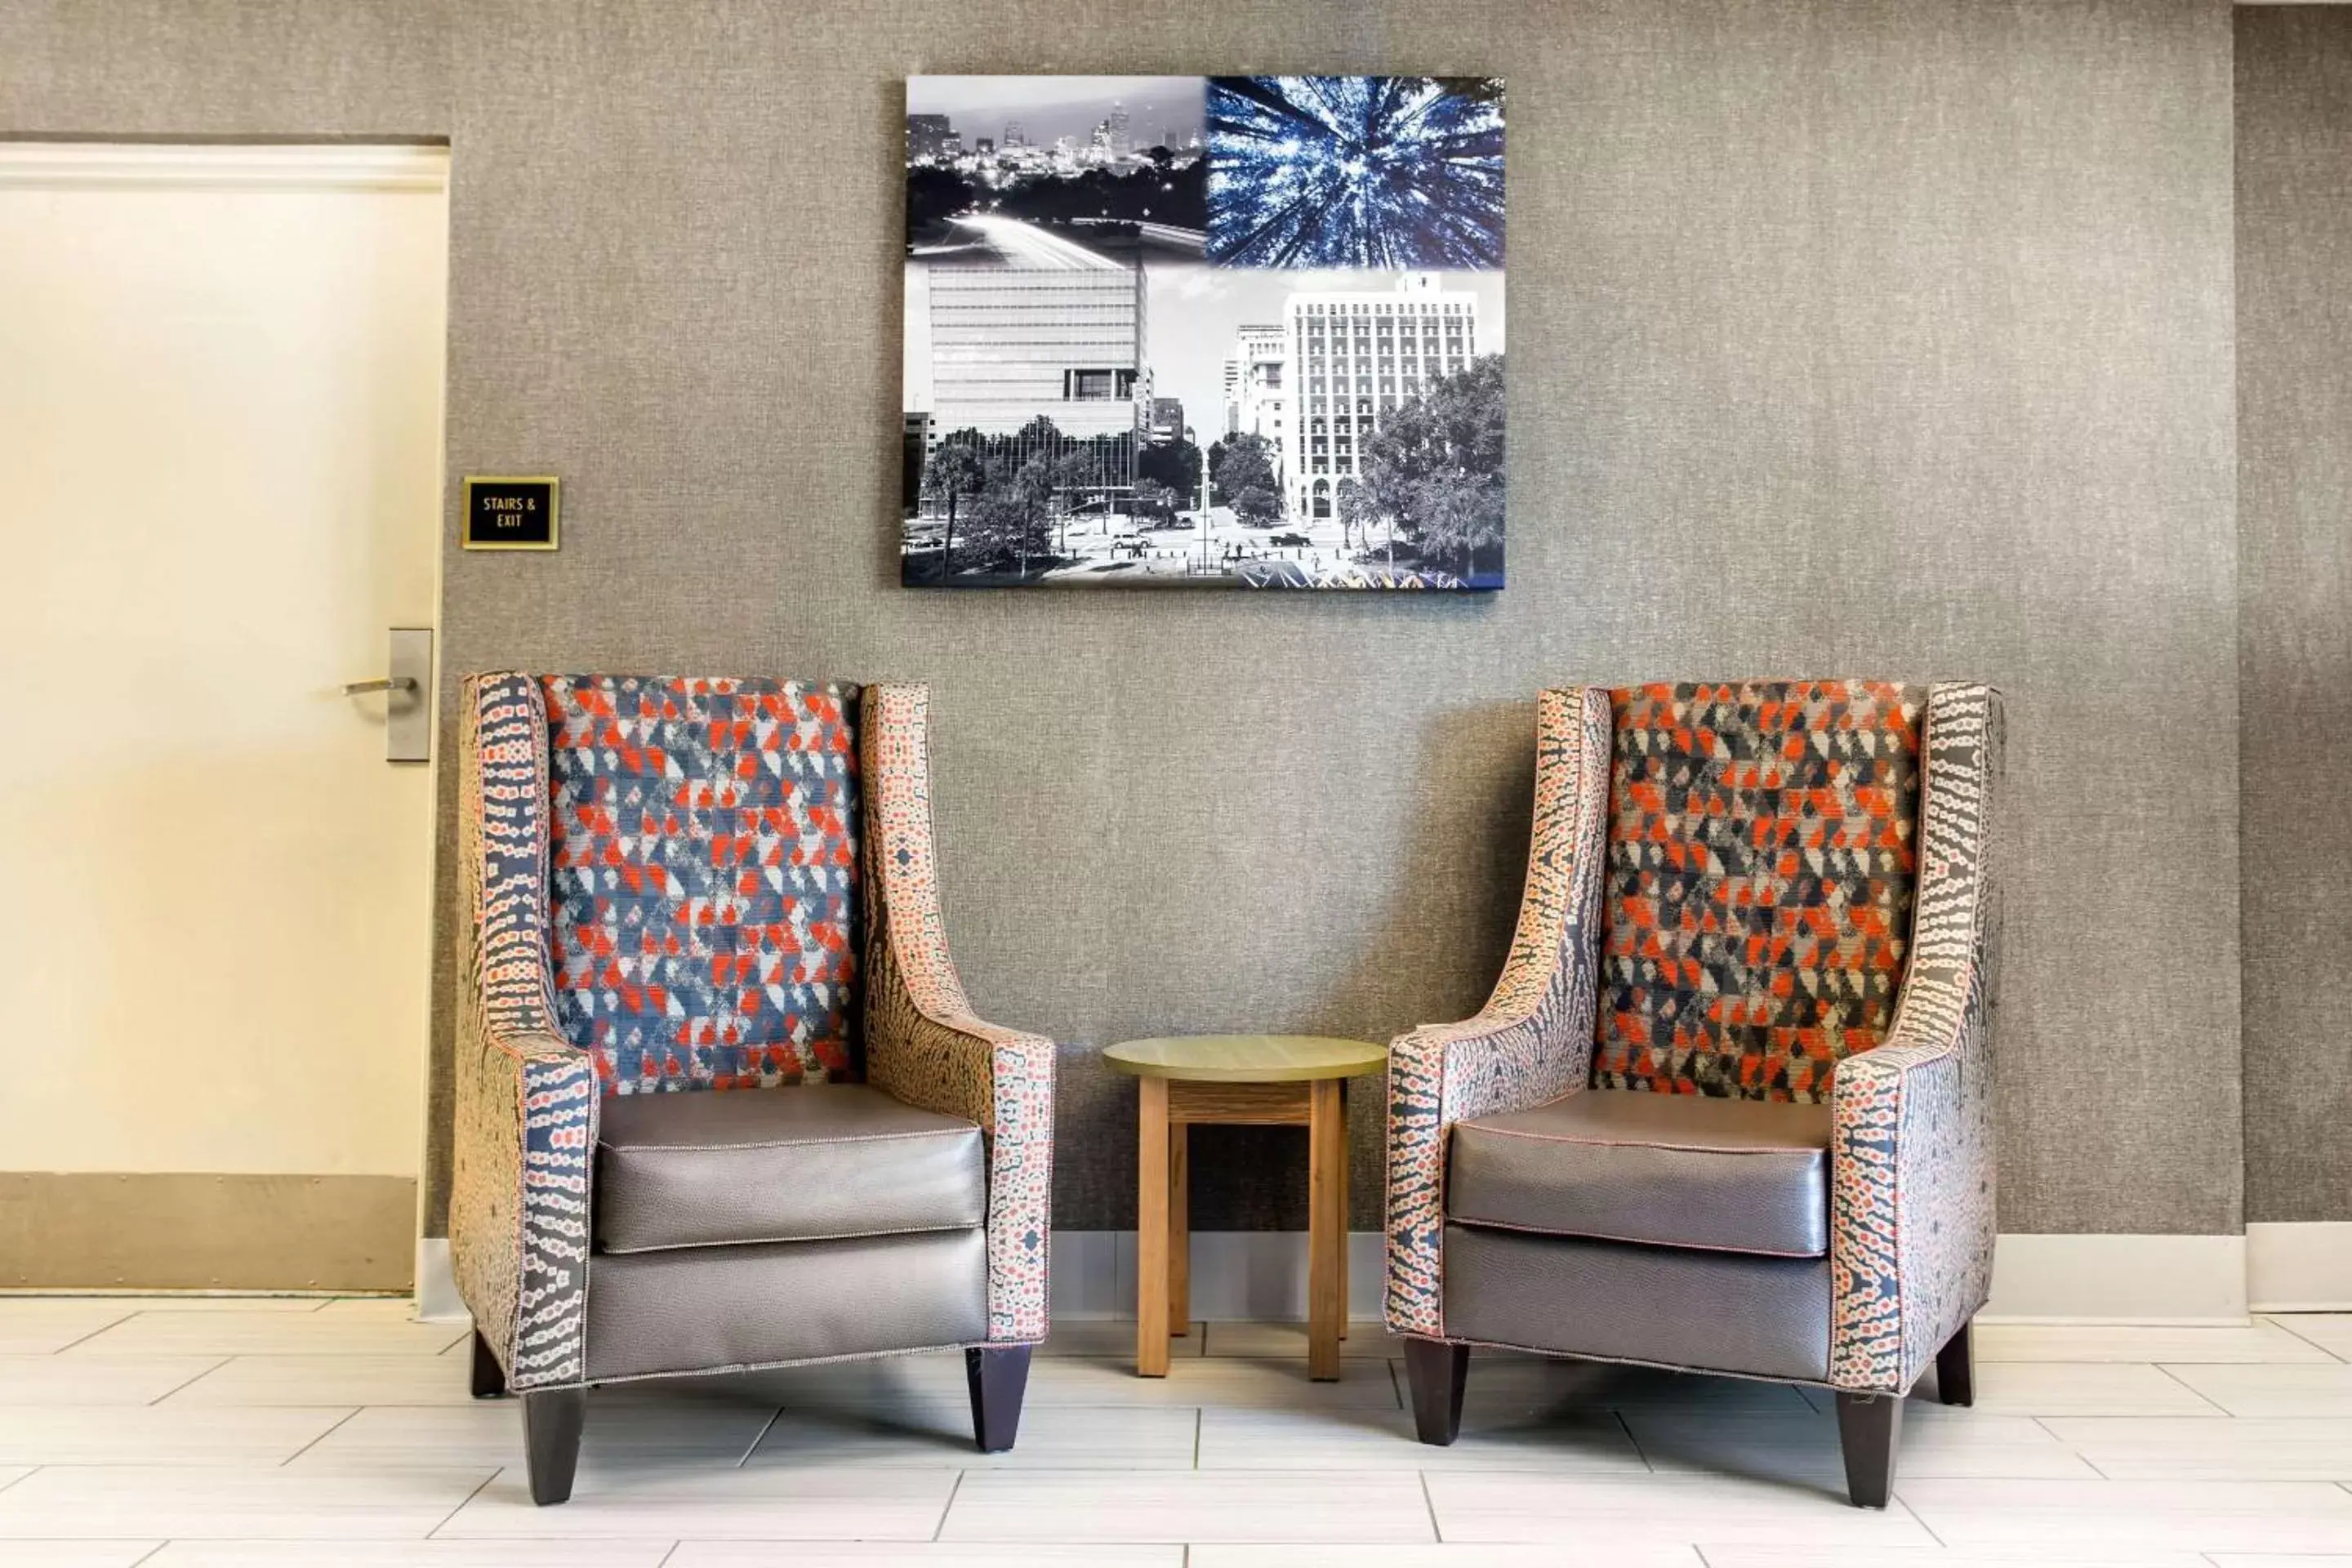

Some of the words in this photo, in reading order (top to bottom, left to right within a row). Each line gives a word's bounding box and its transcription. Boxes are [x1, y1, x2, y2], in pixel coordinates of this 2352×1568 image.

[483, 497, 523, 510] STAIRS
[527, 497, 536, 510] &
[497, 514, 522, 528] EXIT
